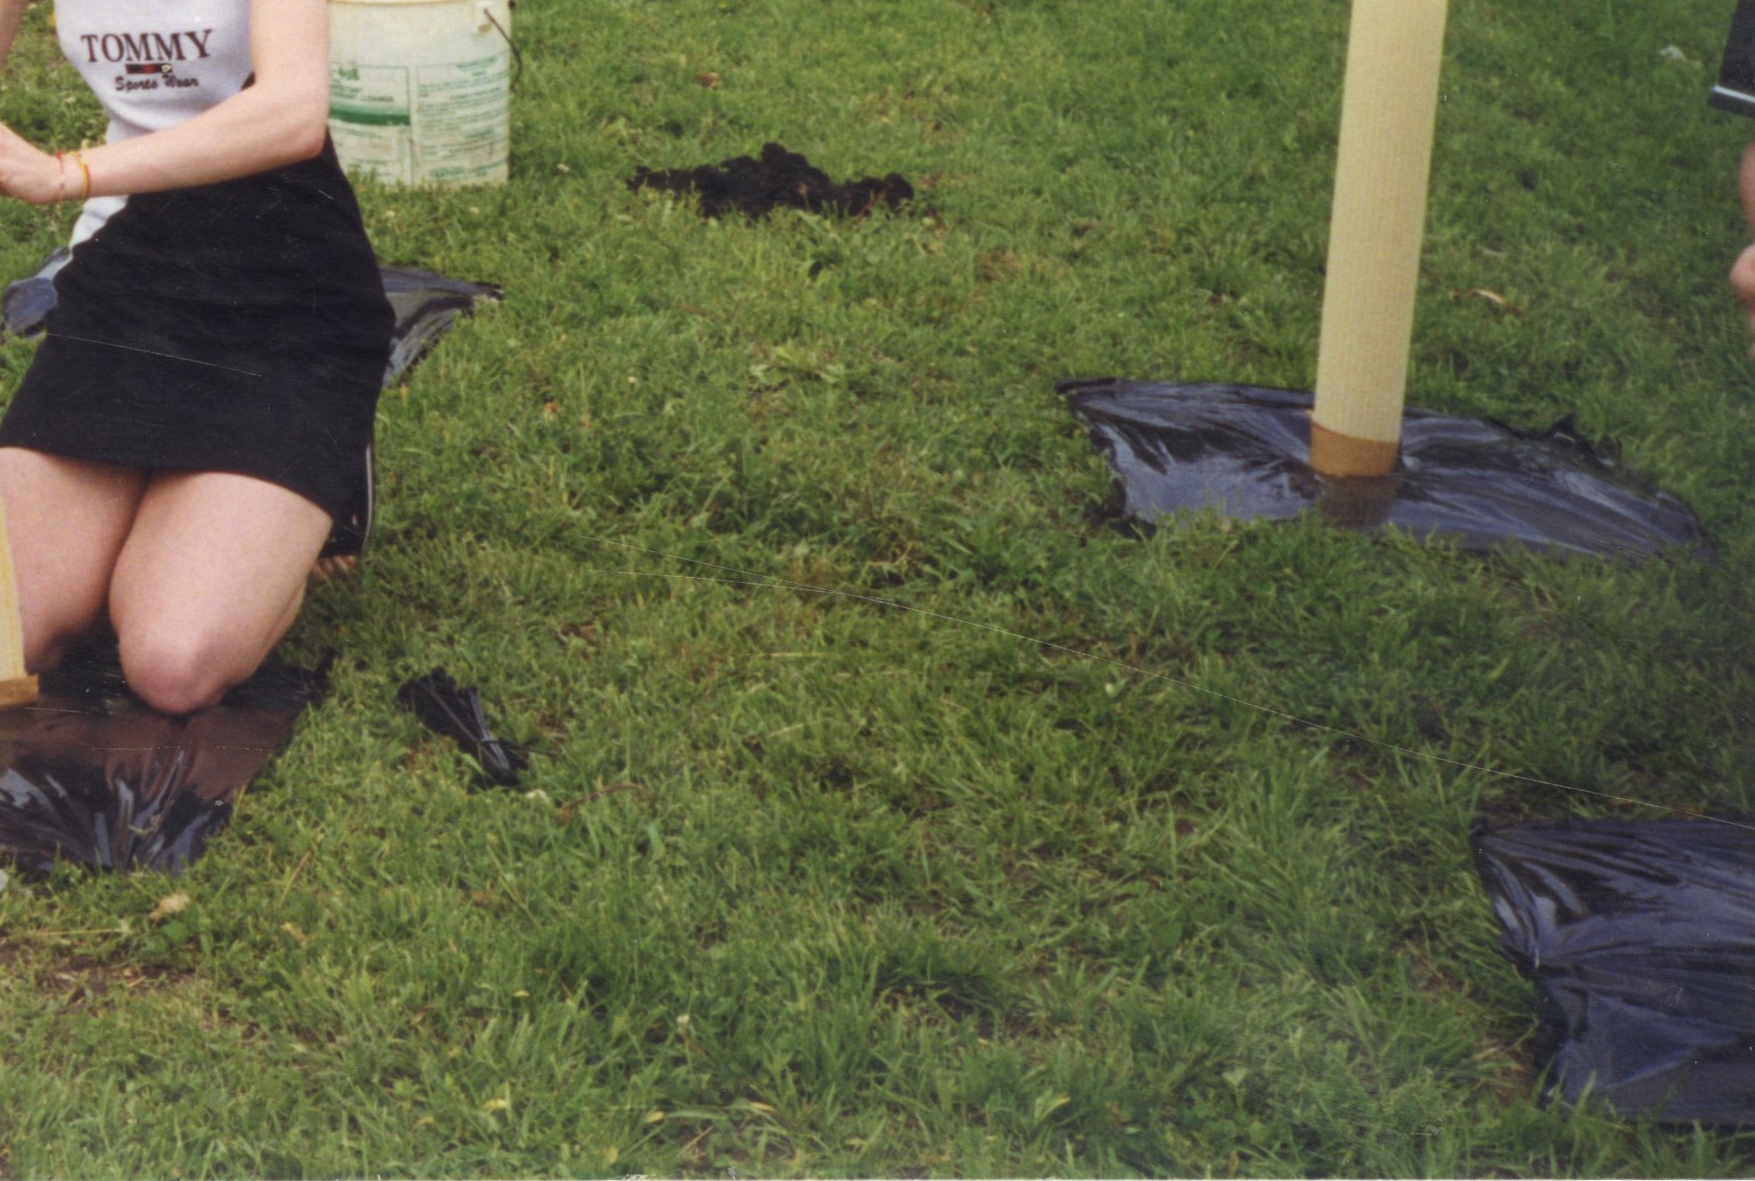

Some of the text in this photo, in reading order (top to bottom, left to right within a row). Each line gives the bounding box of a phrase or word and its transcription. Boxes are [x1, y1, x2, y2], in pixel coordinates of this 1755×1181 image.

[80, 28, 213, 63] TOMMY
[114, 74, 199, 92] Sports Wear
